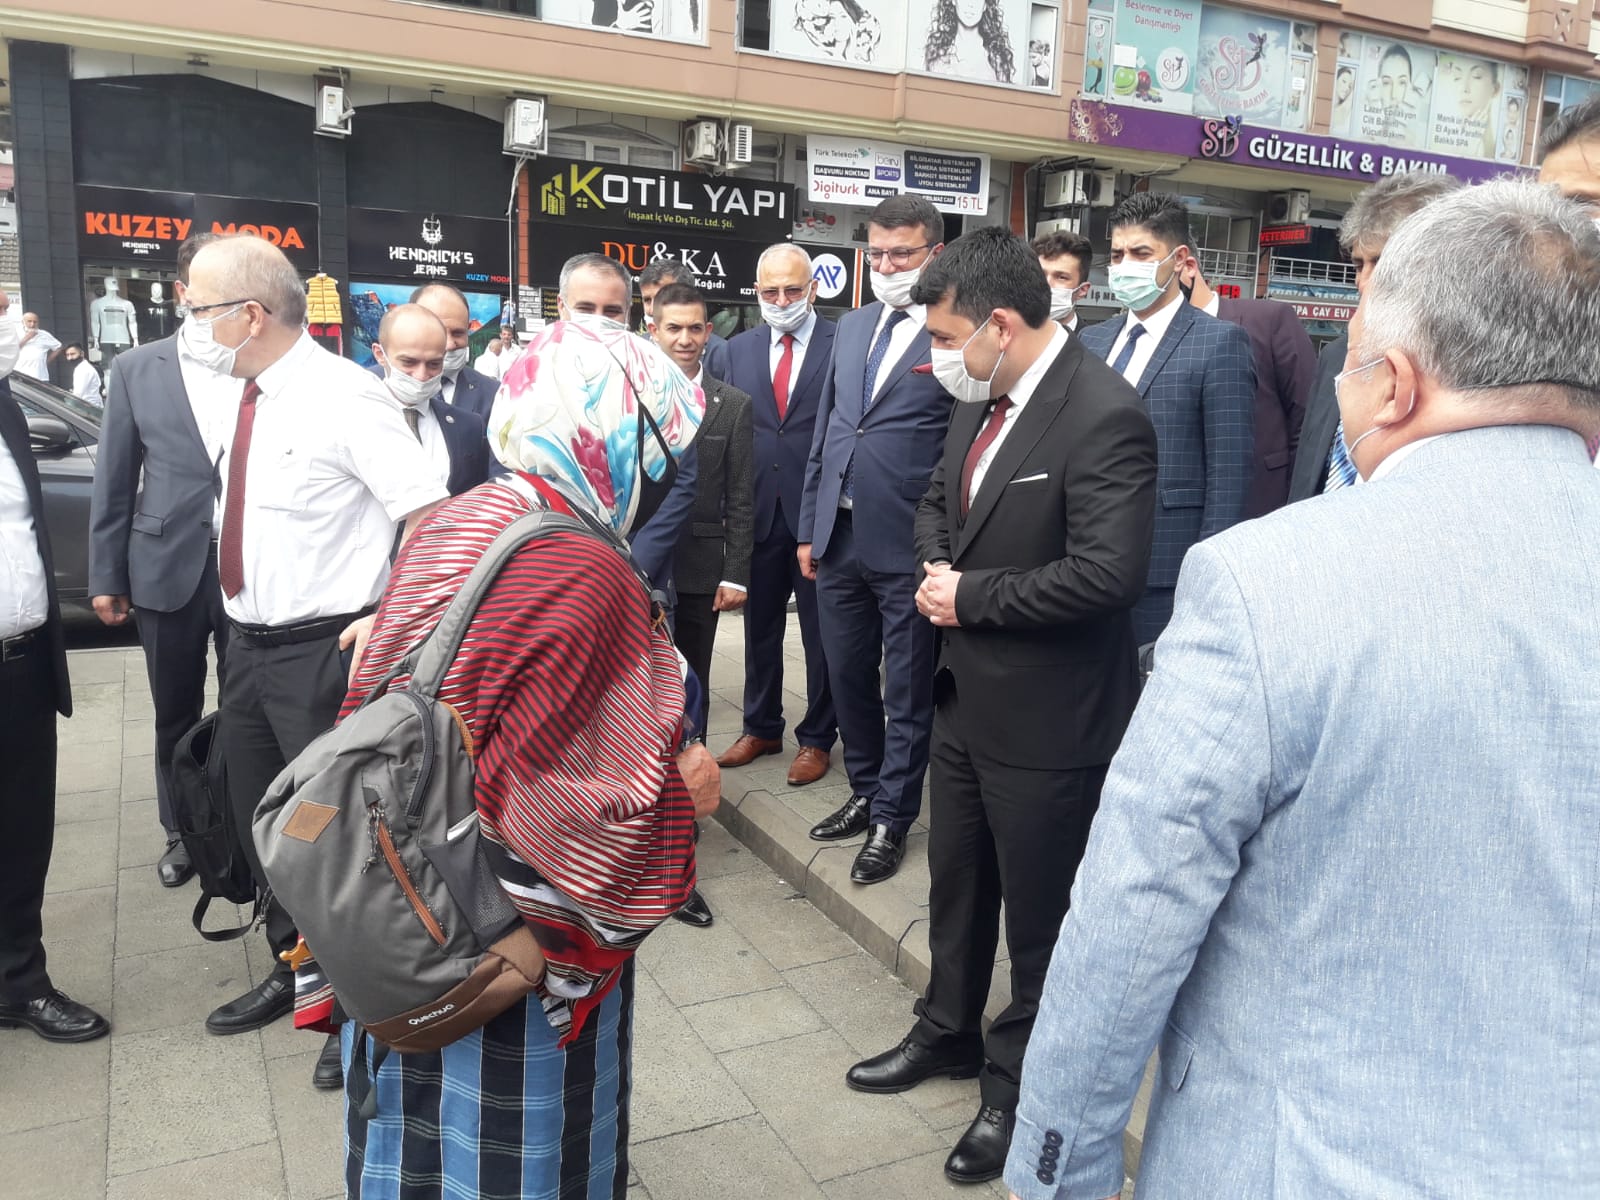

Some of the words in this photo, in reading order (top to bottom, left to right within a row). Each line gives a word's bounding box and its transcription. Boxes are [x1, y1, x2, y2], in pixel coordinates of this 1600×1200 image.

[1249, 134, 1353, 171] GÜZELLİK
[1359, 152, 1375, 173] &
[1381, 156, 1447, 176] BAKIM
[570, 164, 694, 210] KOTİL
[703, 184, 785, 219] YAPI
[957, 196, 968, 209] 15
[971, 197, 983, 210] TL
[663, 214, 675, 223] Ve
[85, 211, 192, 241] KUZEY
[211, 221, 305, 249] MODA
[389, 246, 474, 265] HENDRICK'S
[413, 264, 448, 275] JEANS
[465, 273, 490, 282] KUZEY
[694, 278, 725, 290] Kağıdı
